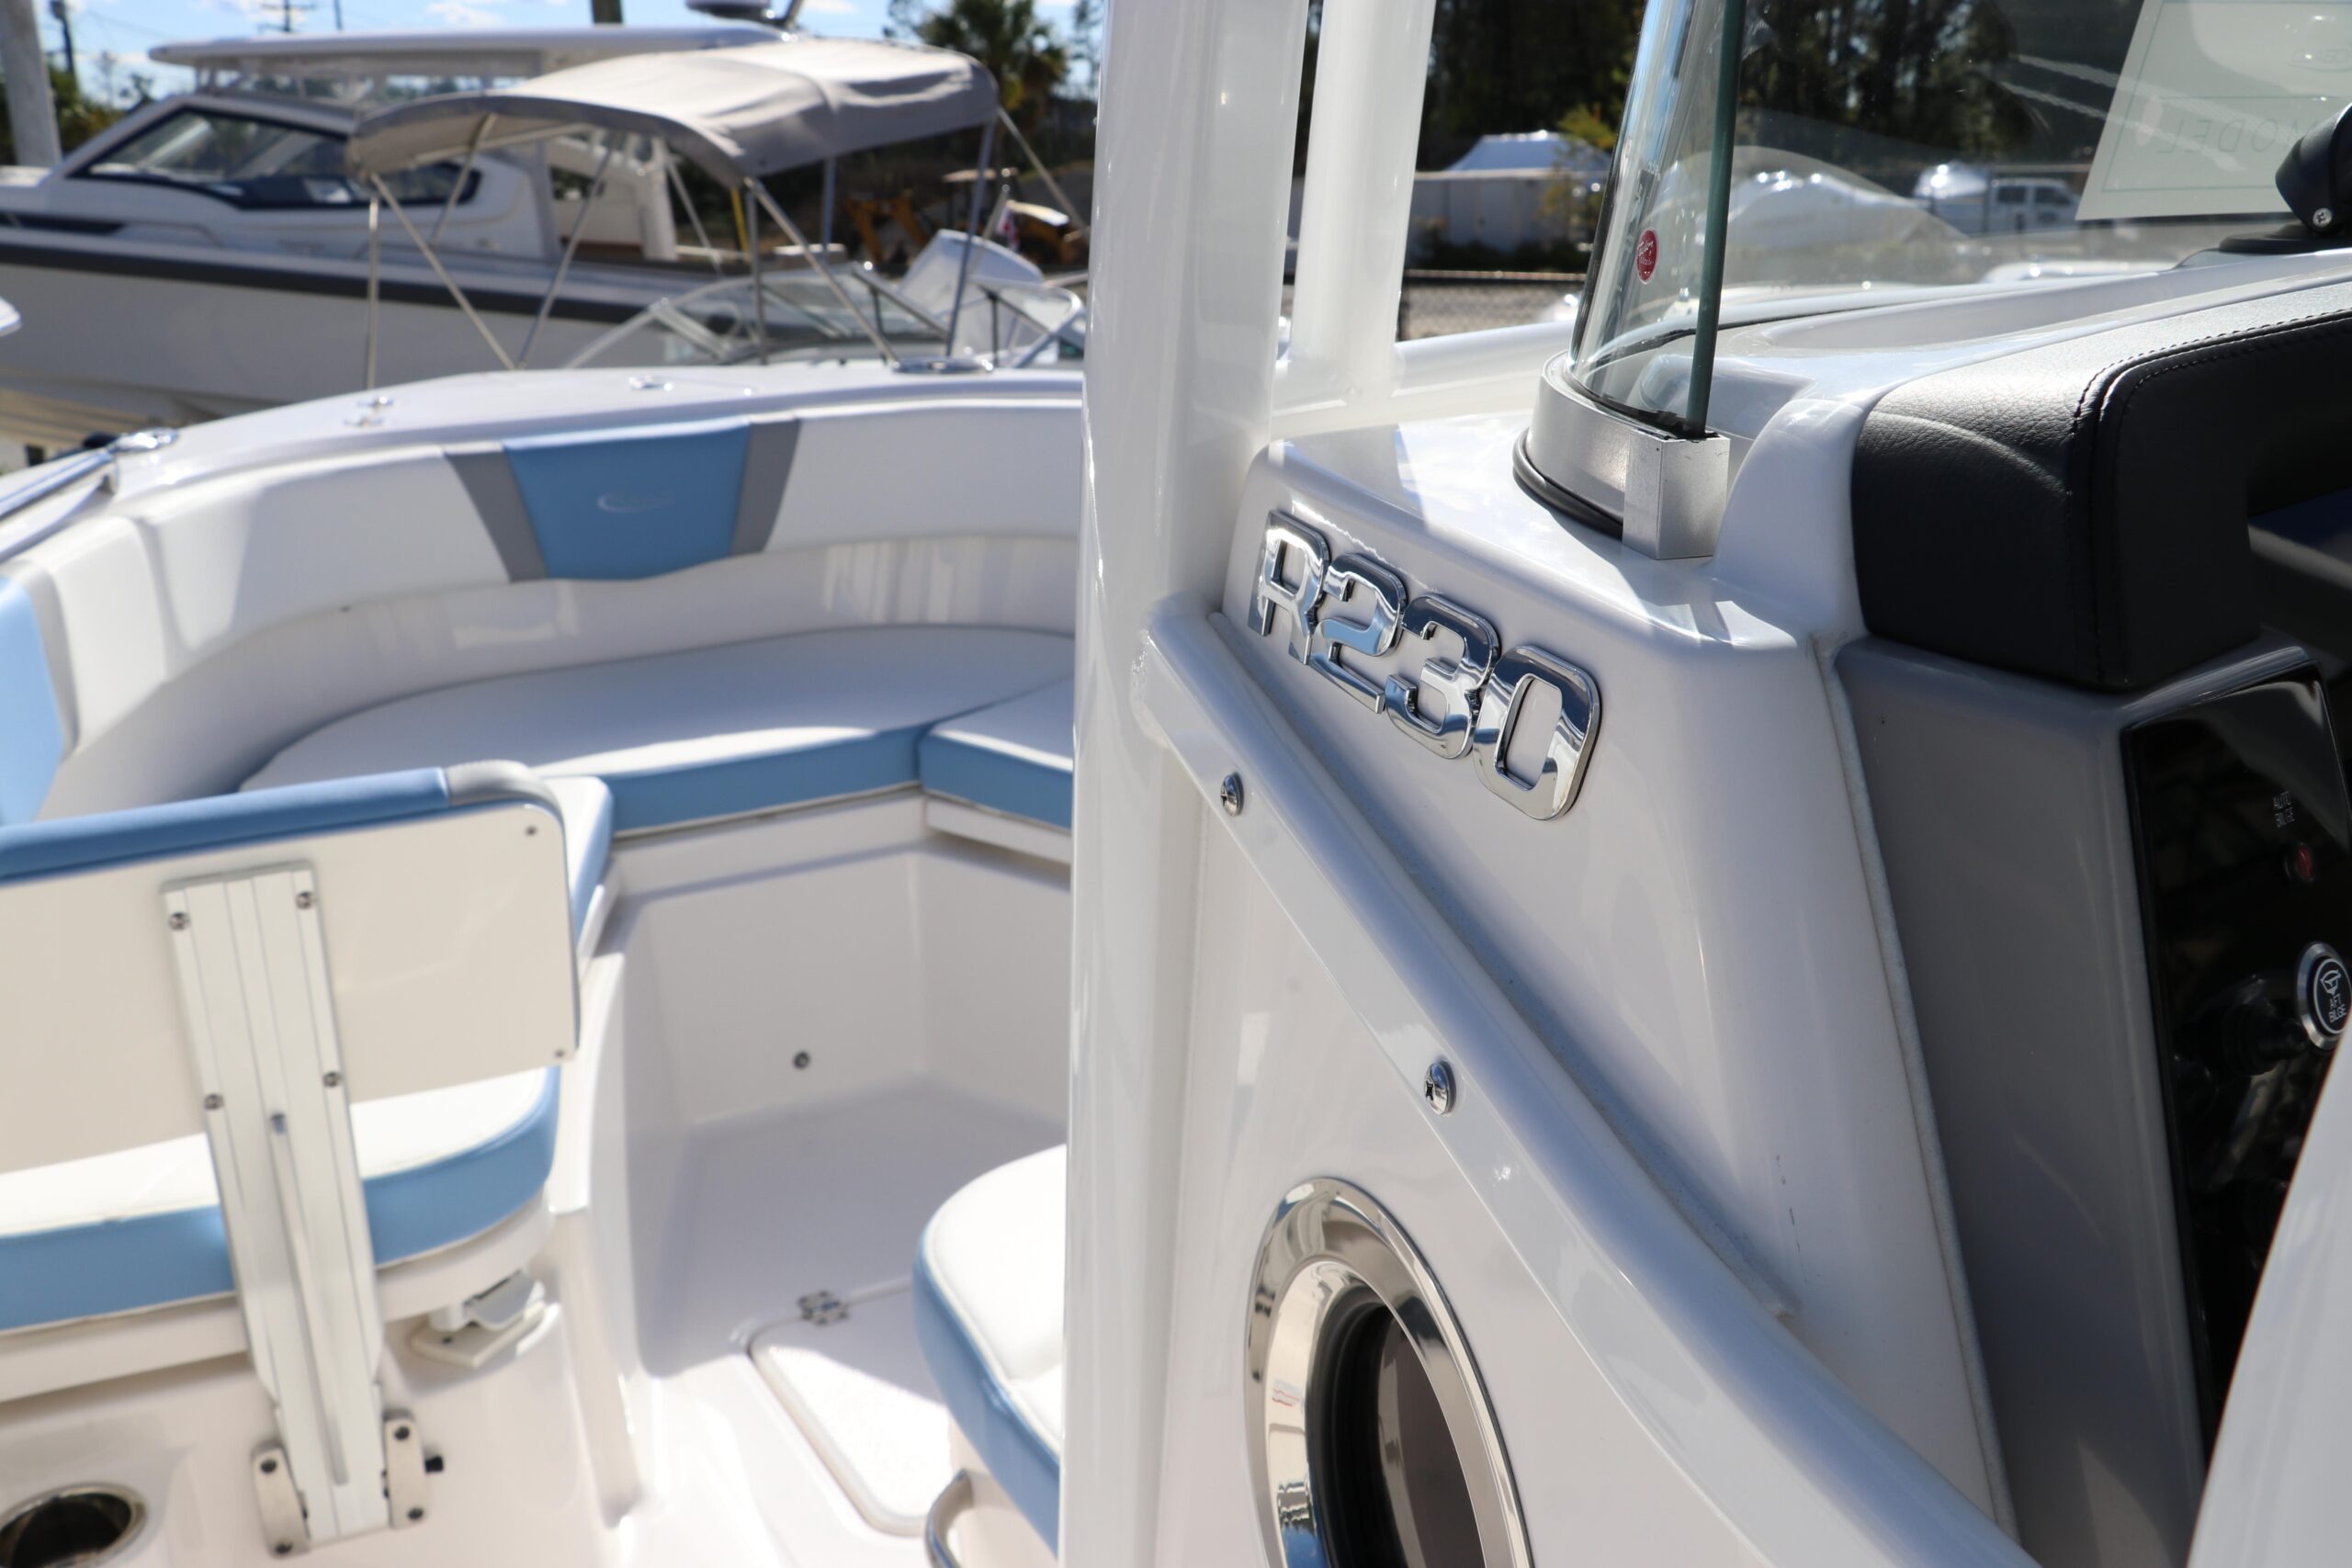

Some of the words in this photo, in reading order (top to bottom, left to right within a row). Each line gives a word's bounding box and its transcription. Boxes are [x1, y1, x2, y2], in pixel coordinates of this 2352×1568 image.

[1247, 508, 1603, 821] R230
[2273, 790, 2291, 810] AUTO
[2274, 807, 2295, 829] BILGE
[2329, 993, 2342, 1010] AFT
[2328, 1004, 2346, 1023] BILGE
